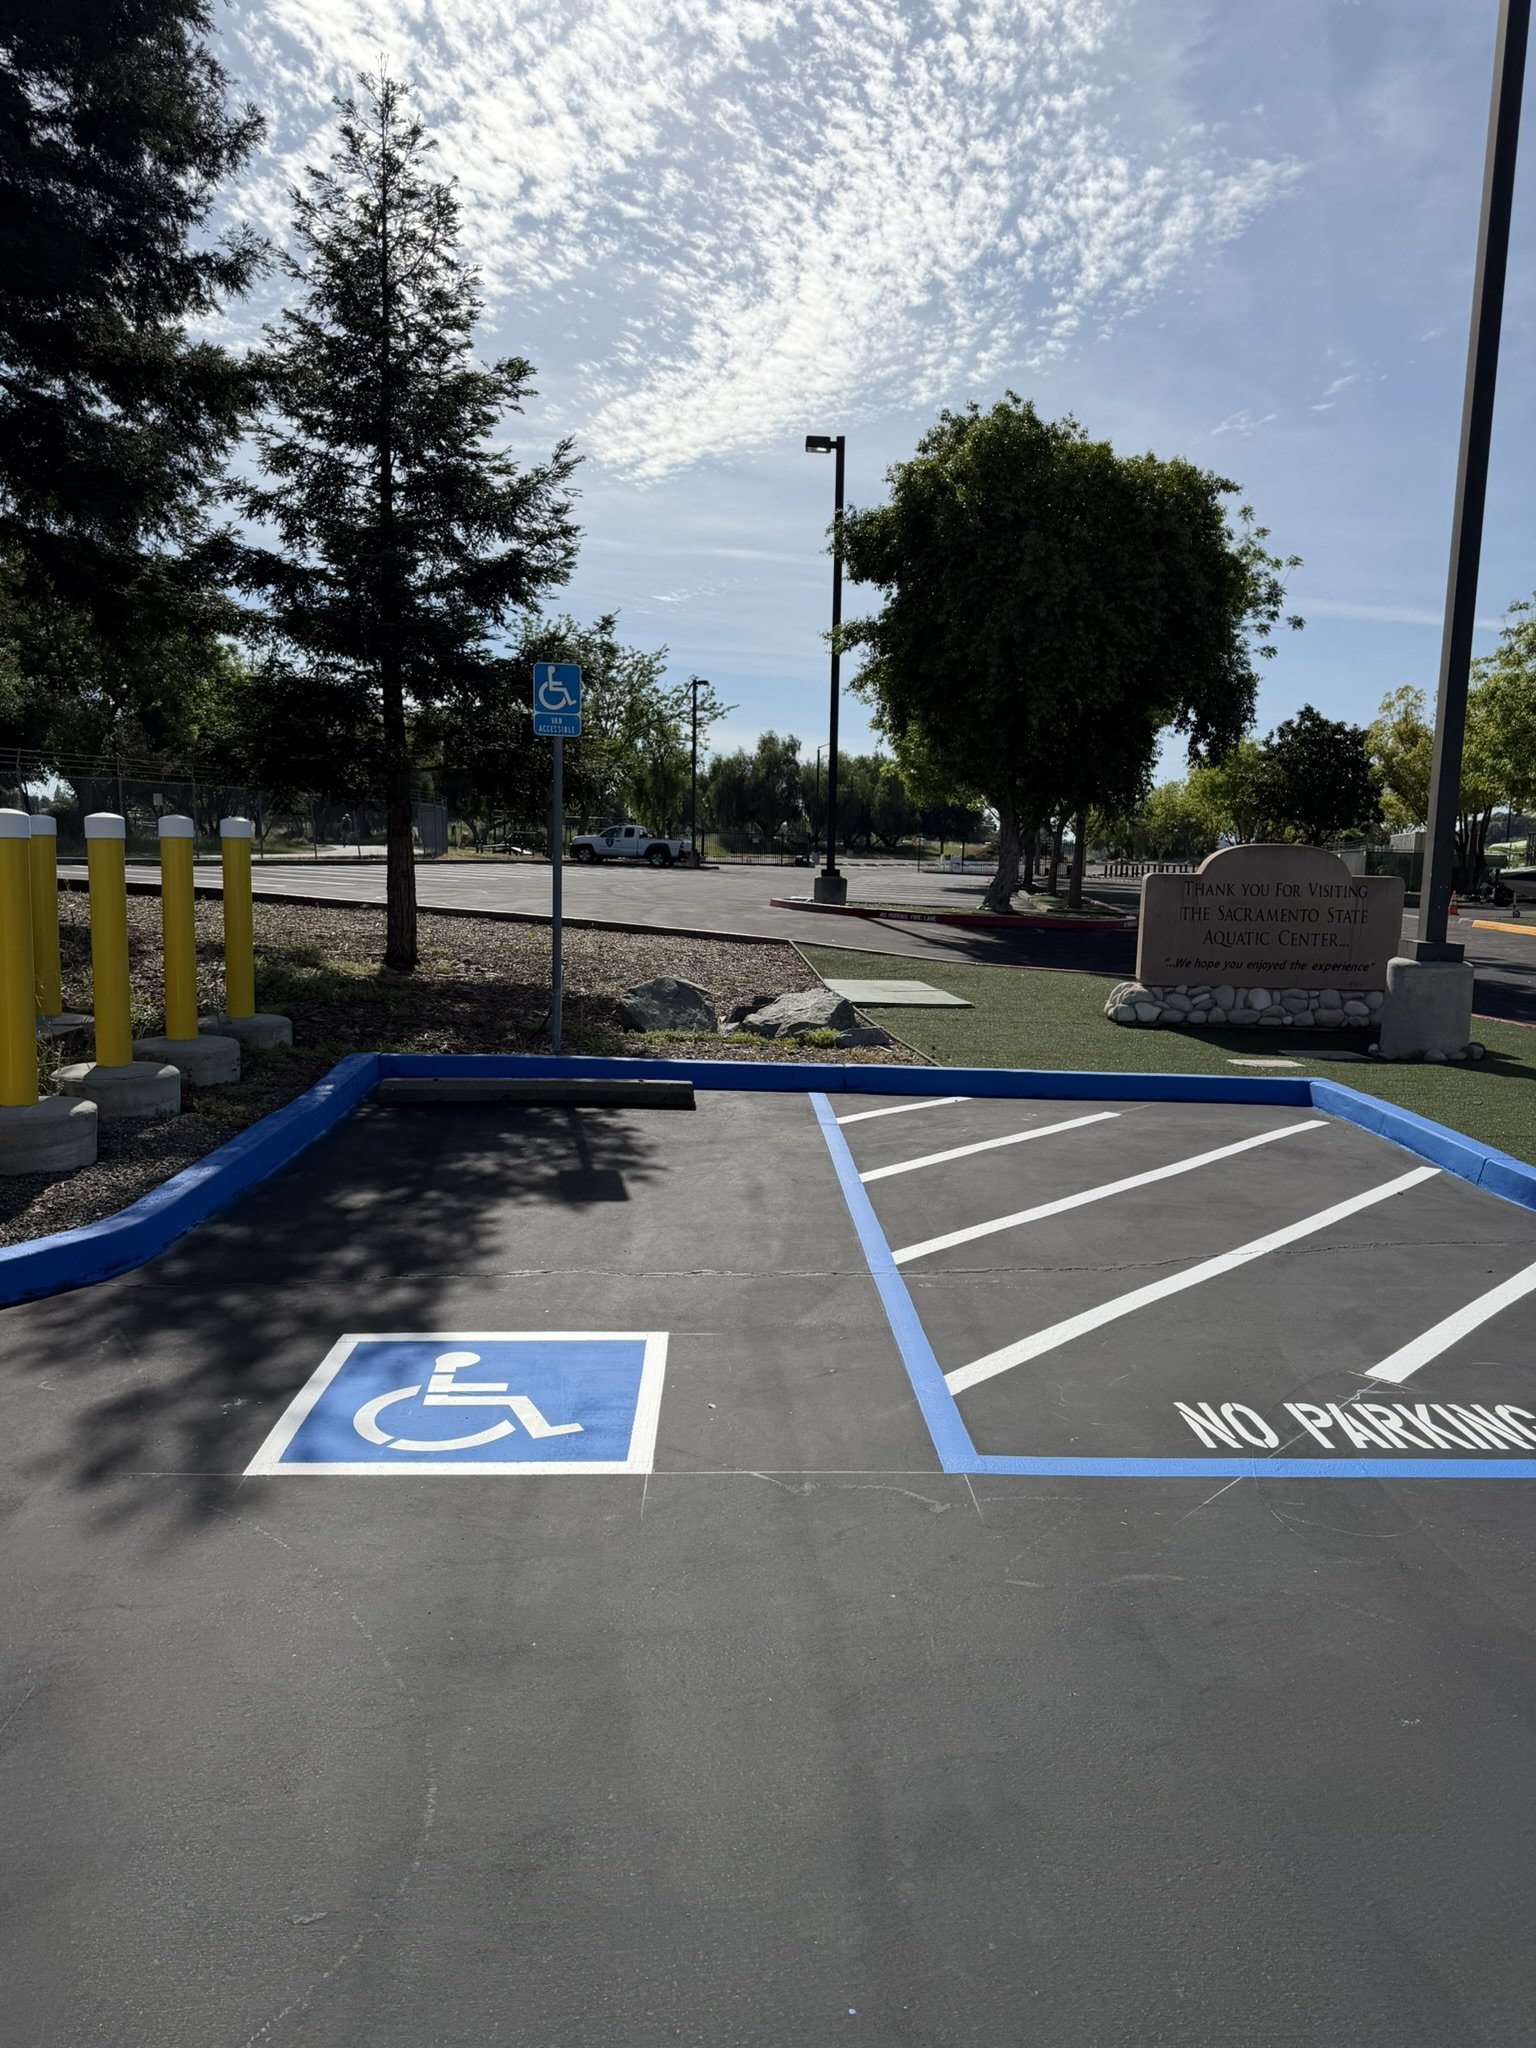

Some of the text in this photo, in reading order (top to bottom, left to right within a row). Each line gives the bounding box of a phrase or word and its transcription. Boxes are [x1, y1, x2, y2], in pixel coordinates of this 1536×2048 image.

[538, 725, 575, 733] ACCESSIBLE
[1184, 880, 1369, 899] THANK YOU FOR VISITING
[1181, 904, 1369, 924] THE SACRAMENTO STATE
[1203, 929, 1270, 948] AQUATIC
[1194, 957, 1221, 971] hope
[1223, 960, 1243, 971] you
[1246, 959, 1288, 973] enjoyed
[1289, 959, 1308, 970] the
[1173, 1402, 1279, 1449] NO
